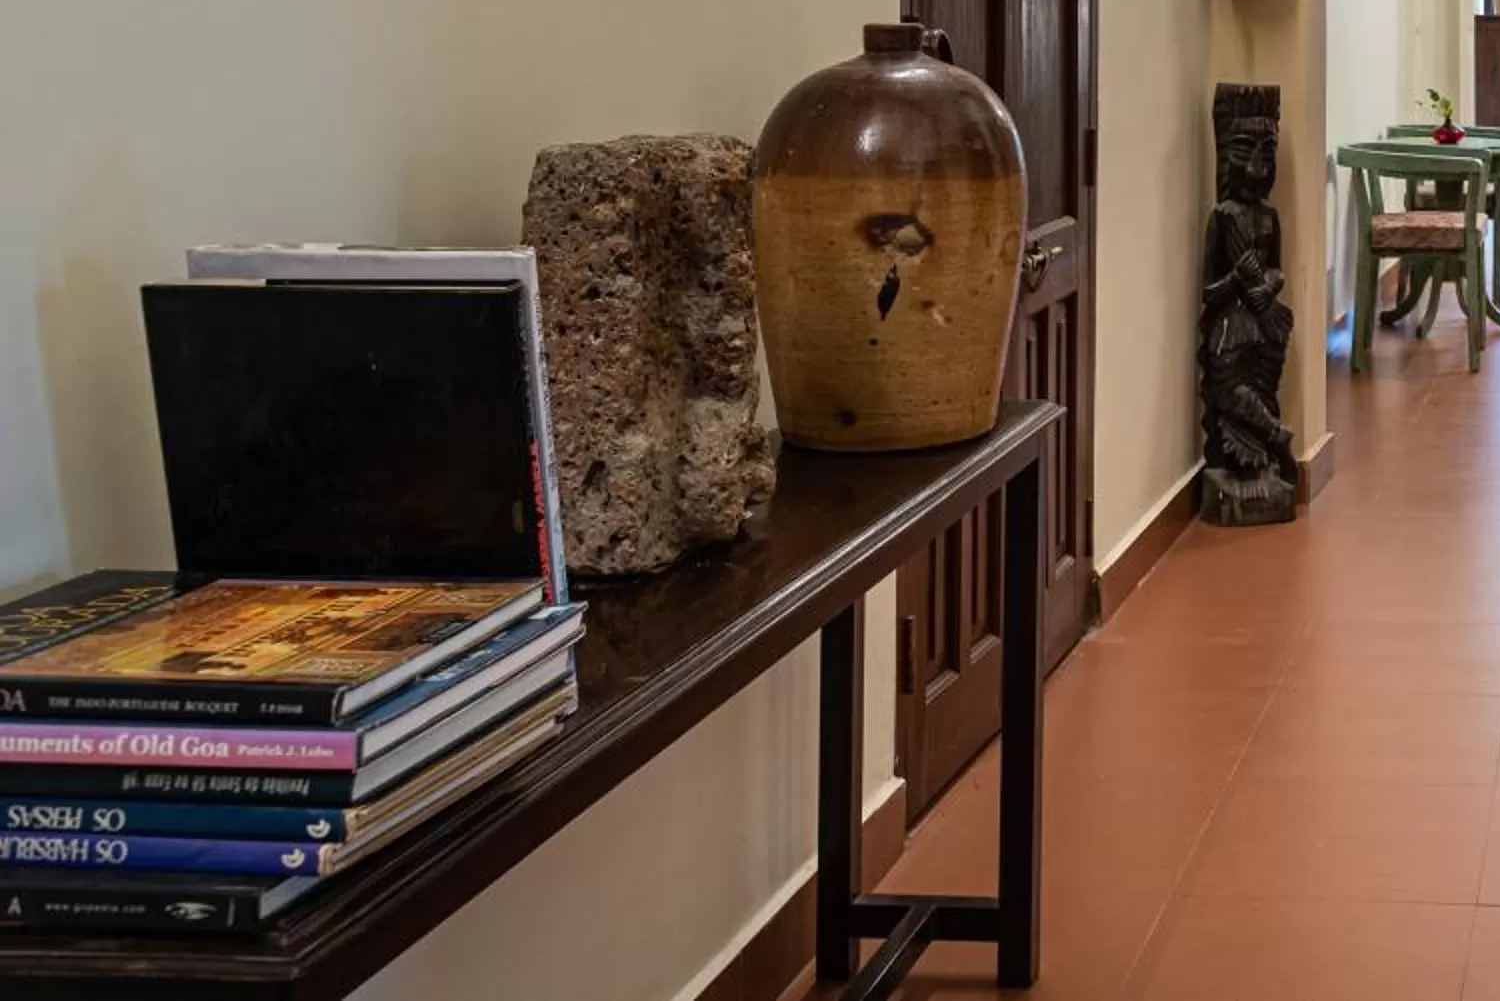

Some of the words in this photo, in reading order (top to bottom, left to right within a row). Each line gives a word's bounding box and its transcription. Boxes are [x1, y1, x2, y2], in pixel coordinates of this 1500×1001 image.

[99, 733, 129, 755] of
[130, 734, 175, 756] Old
[180, 736, 229, 758] Goa
[237, 744, 284, 756] Patrick
[93, 808, 126, 832] OS
[95, 839, 129, 864] OS
